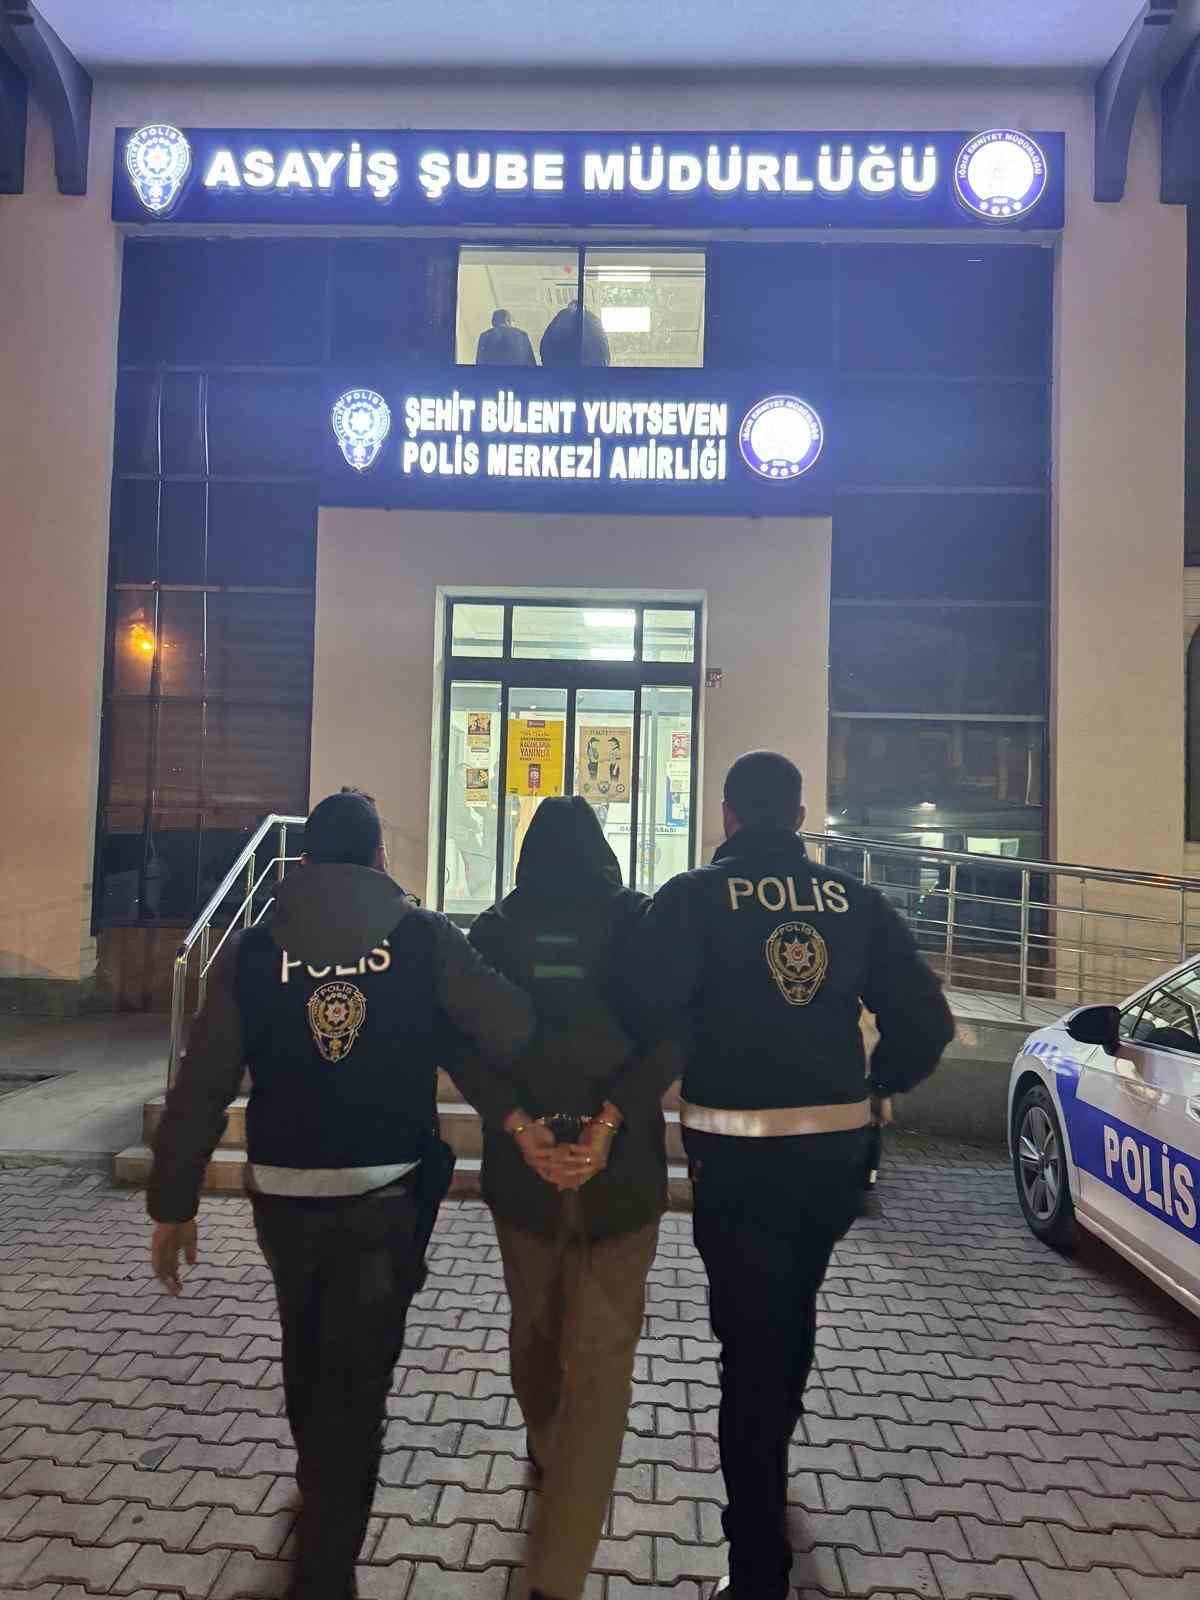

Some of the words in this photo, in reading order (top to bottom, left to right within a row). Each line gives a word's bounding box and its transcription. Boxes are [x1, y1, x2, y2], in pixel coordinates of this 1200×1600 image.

[204, 143, 399, 198] ASAYİŞ
[418, 153, 565, 199] ŞUBE
[585, 146, 937, 192] MÜDÜRLÜĞÜ
[404, 390, 476, 438] ŞEHİT
[481, 390, 577, 434] BÜLENT
[582, 401, 728, 436] YURTSEVEN
[403, 434, 480, 475] POLİS
[487, 437, 601, 479] MERKEZİ
[609, 438, 727, 480] AMİRLİĞİ
[727, 876, 849, 913] POLİS
[1103, 1124, 1197, 1230] POLİS
